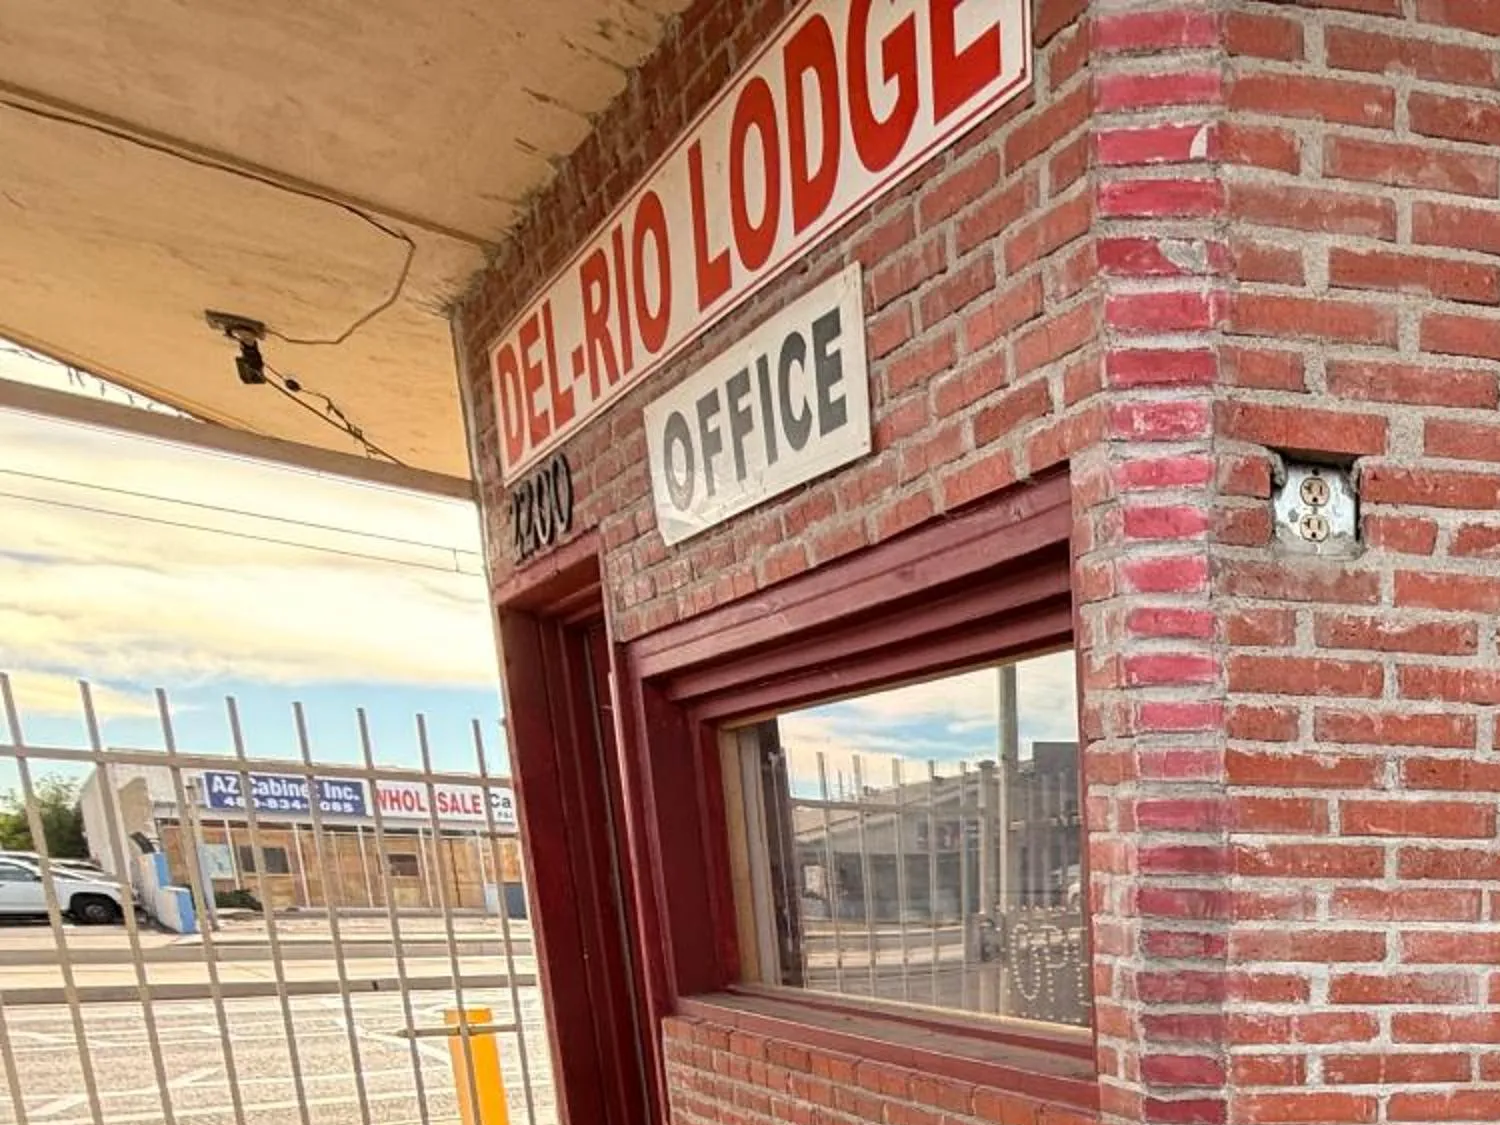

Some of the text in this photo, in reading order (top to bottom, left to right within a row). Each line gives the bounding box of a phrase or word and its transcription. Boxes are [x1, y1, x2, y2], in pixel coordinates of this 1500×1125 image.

[496, 190, 672, 464] DEL-RIO
[662, 306, 848, 513] OFFICE
[211, 775, 241, 796] AZ
[323, 781, 361, 801] Inc.
[374, 787, 483, 815] WHOLSALE
